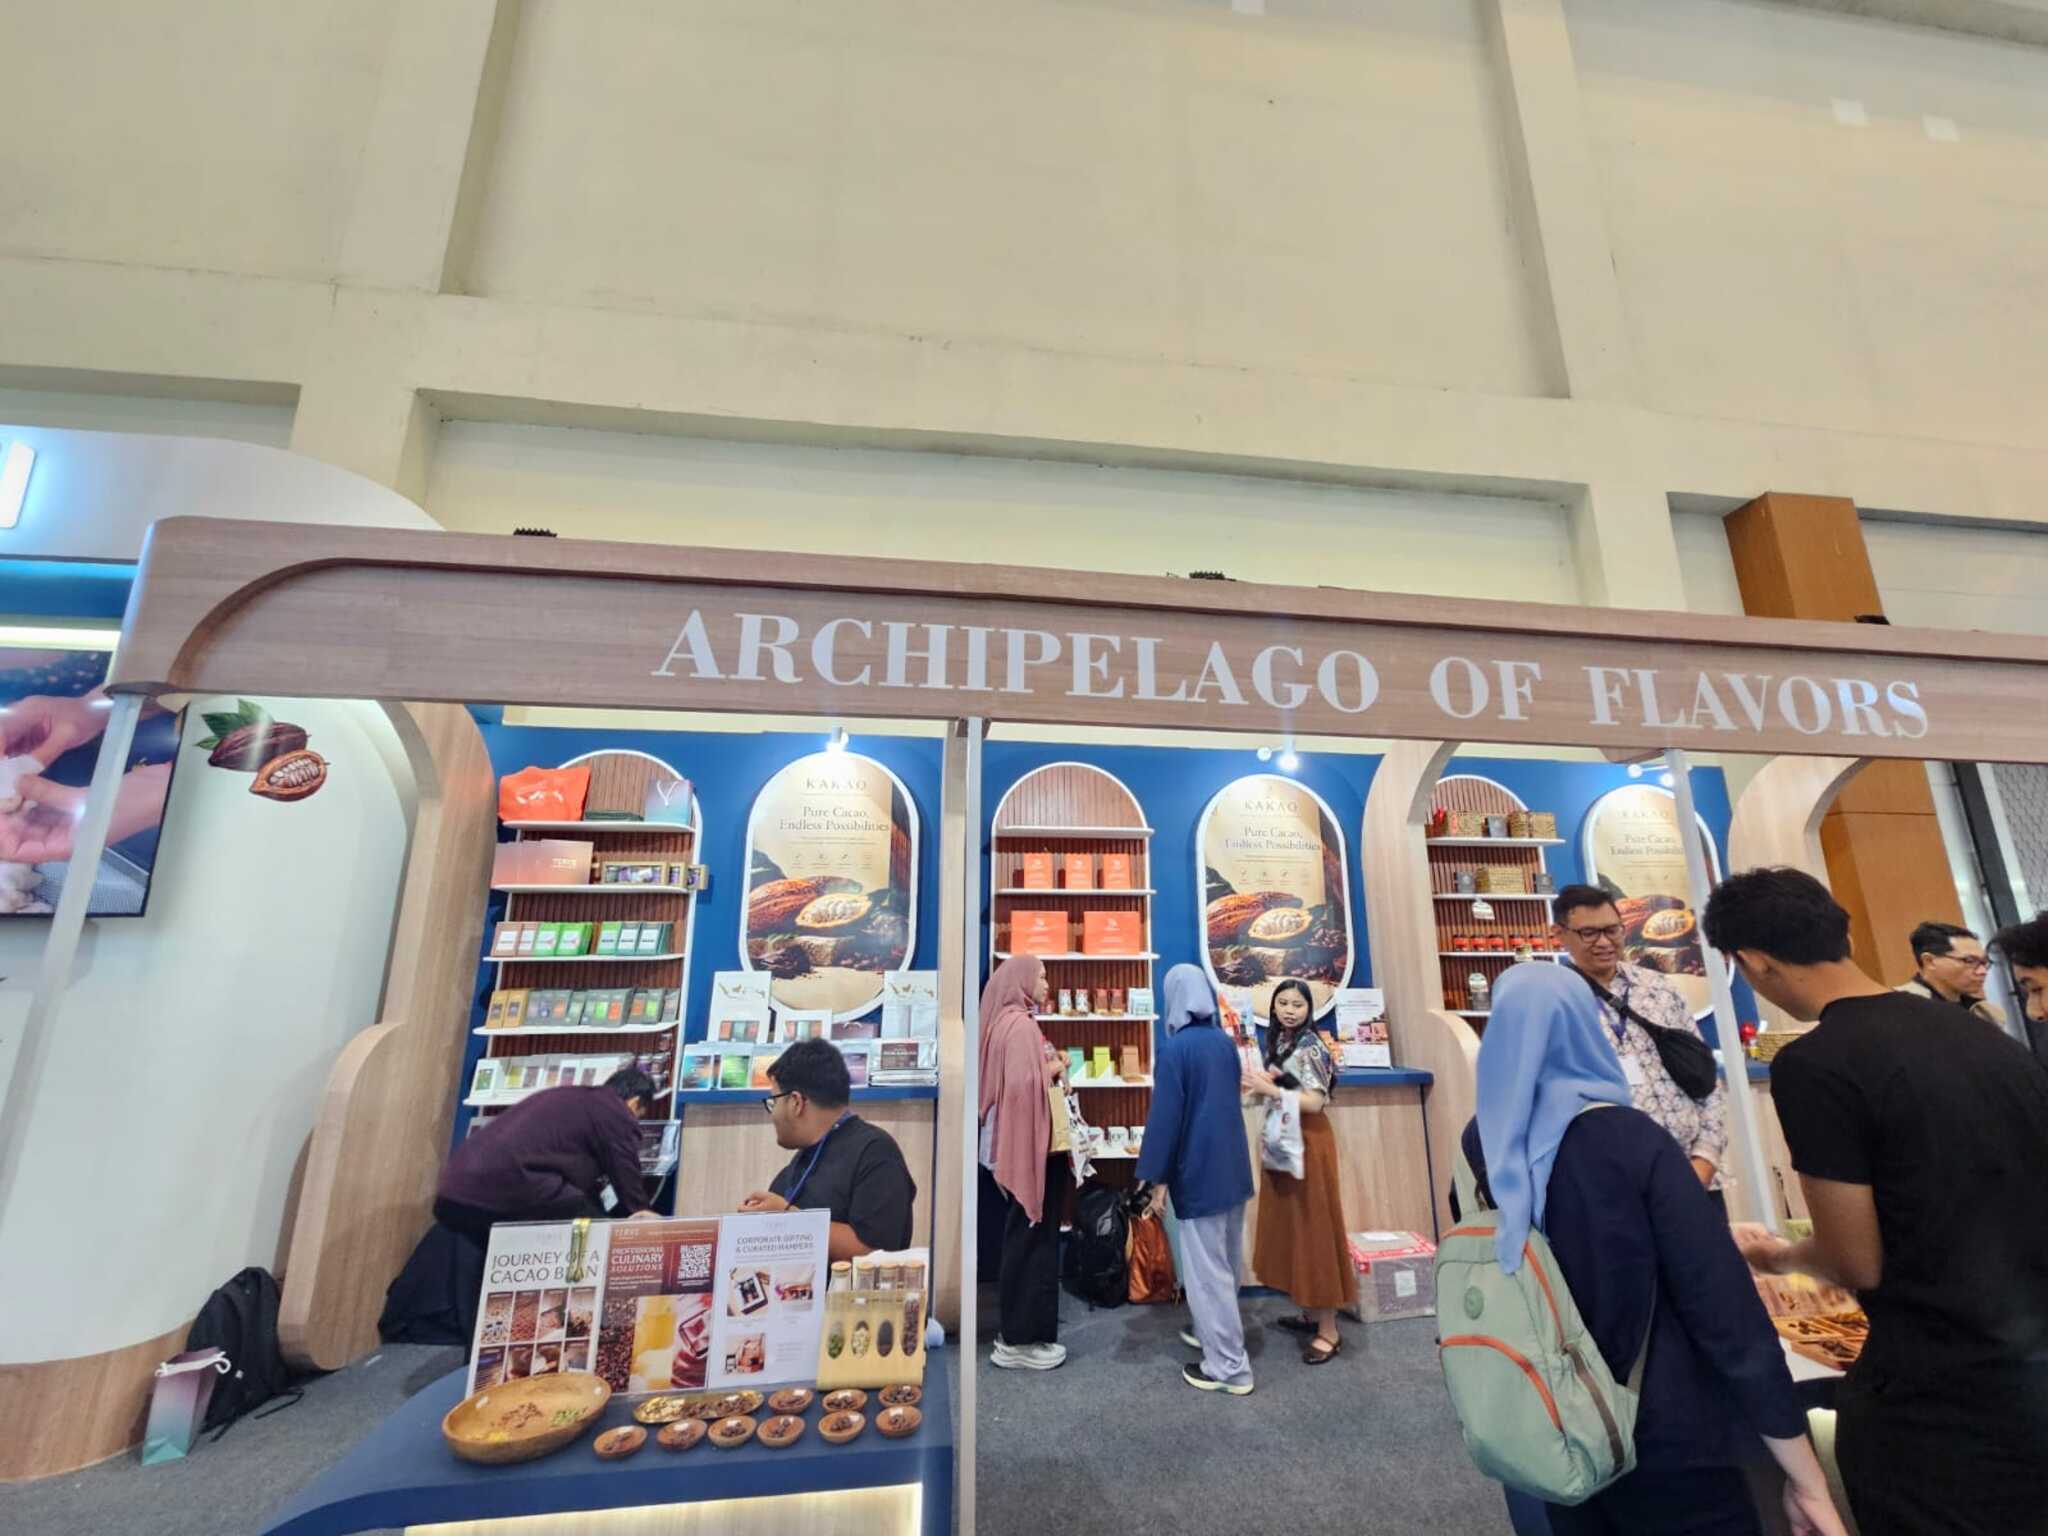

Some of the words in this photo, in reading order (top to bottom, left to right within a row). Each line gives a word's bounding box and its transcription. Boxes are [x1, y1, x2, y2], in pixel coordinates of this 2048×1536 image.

[651, 609, 1379, 714] ARCHIPELAGO
[1429, 656, 1543, 721] OF
[1582, 666, 1929, 739] FLAVORS
[806, 777, 867, 790] KAKAO
[803, 806, 829, 817] Pure
[1245, 800, 1298, 812] KAKAO
[779, 819, 822, 831] Endless
[825, 819, 890, 832] Possibilities
[1244, 825, 1268, 837] Pure
[1225, 839, 1263, 849] Endless
[492, 1251, 562, 1270] JOURNEY
[589, 1250, 600, 1262] A
[611, 1254, 664, 1265] CULINARY
[490, 1269, 550, 1284] CACAO
[550, 1265, 599, 1280] BN
[611, 1264, 664, 1273] SOLUTIONS
